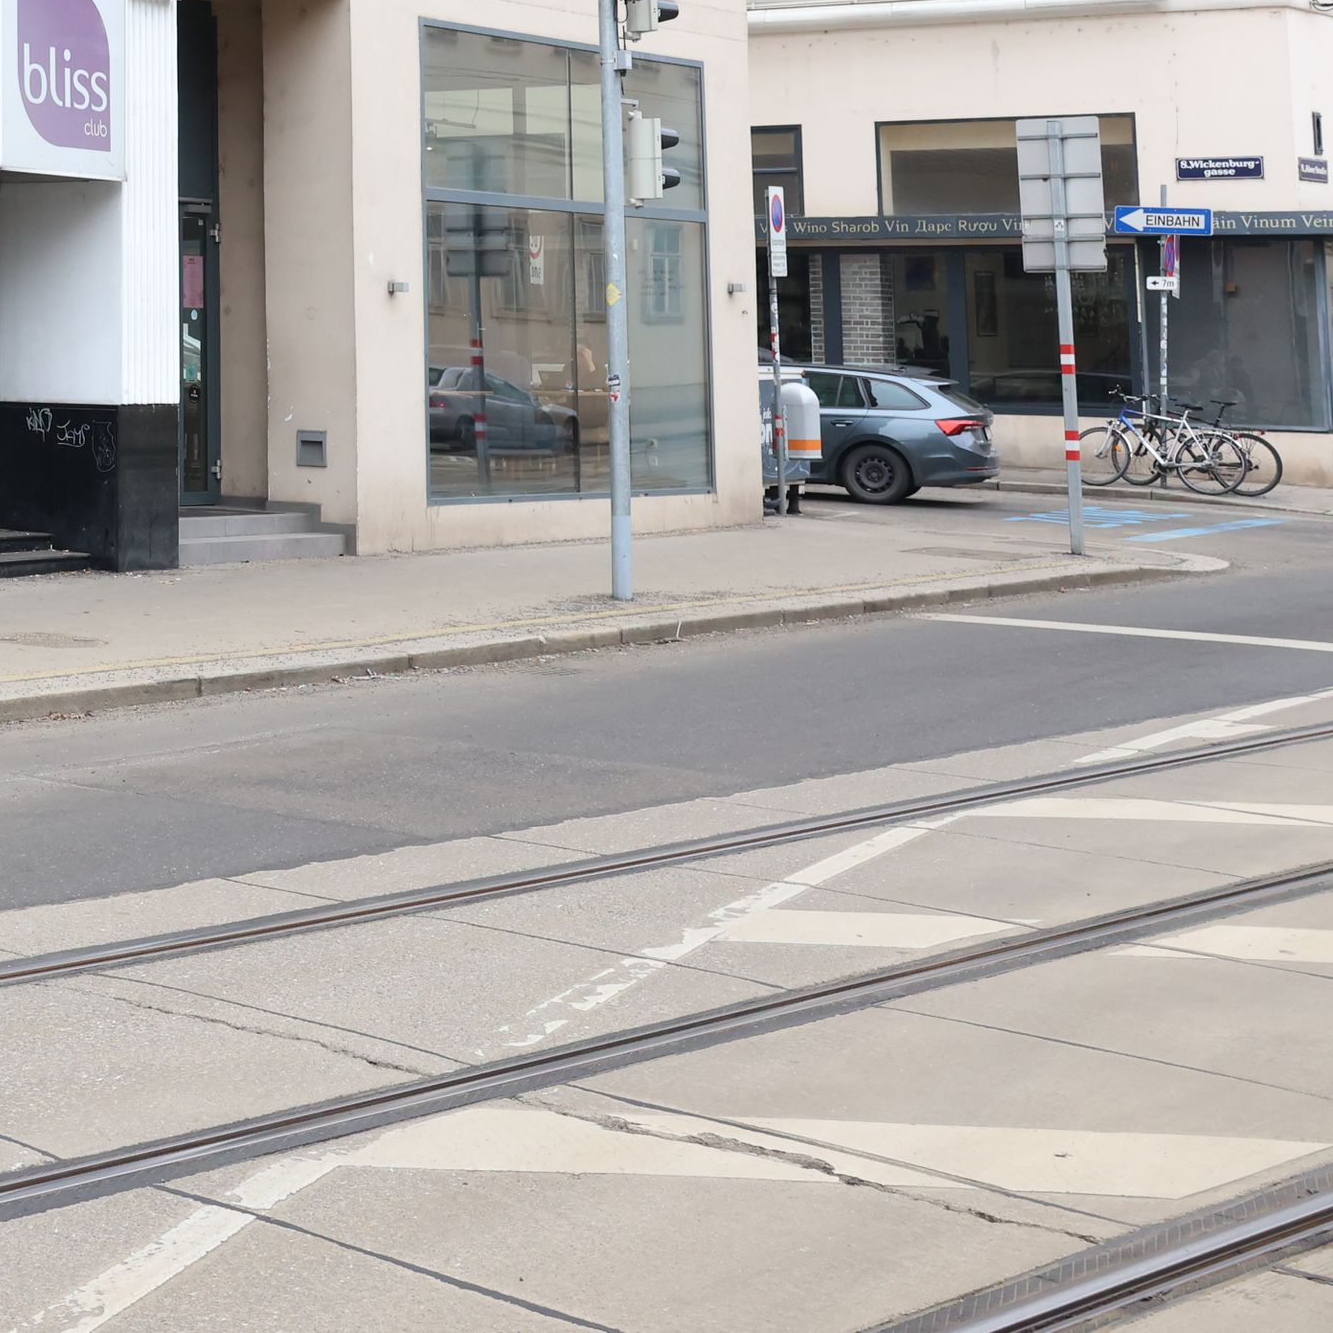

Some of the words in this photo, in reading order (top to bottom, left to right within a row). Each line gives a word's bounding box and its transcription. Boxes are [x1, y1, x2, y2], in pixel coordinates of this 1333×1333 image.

[23, 42, 108, 112] bliss
[84, 118, 108, 138] club
[1203, 168, 1236, 178] gasse
[792, 221, 827, 233] Wino
[831, 220, 880, 233] Sharob
[1240, 214, 1297, 229] Vinum
[1145, 214, 1201, 228] EINBAHN
